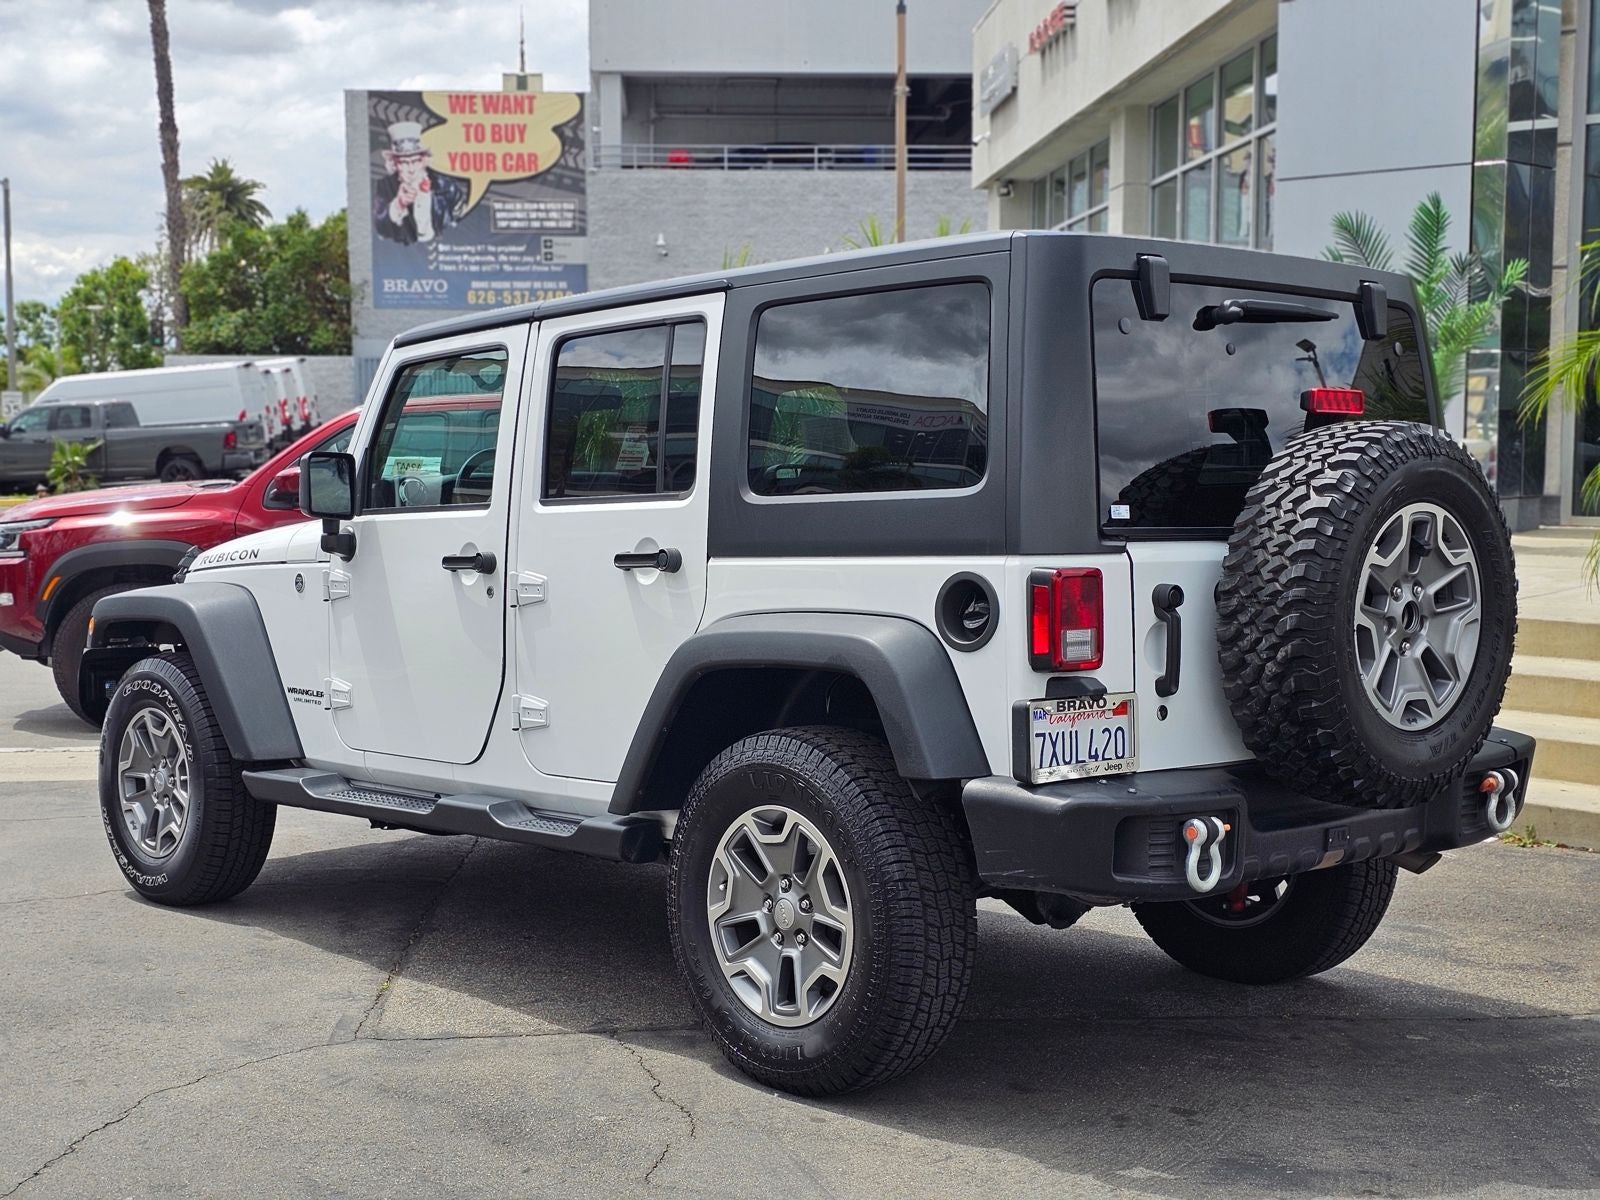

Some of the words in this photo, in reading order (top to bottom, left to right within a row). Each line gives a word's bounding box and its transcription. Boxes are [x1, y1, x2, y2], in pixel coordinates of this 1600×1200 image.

[449, 94, 477, 114] WE
[481, 94, 537, 114] WANT
[463, 123, 486, 143] TO
[491, 123, 527, 143] BUY
[448, 152, 497, 172] YOUR
[502, 152, 538, 172] CAR
[383, 279, 449, 293] BRAVO
[200, 548, 261, 565] RUBICON
[287, 686, 325, 698] WRANGLER
[293, 696, 322, 705] UNLIMITED
[1056, 697, 1107, 712] BRAVO
[122, 679, 194, 762] GOODYEAR
[1033, 709, 1047, 721] MAR
[1049, 711, 1113, 728] California
[1034, 725, 1126, 769] 7XUL420
[1104, 761, 1123, 772] Jeep
